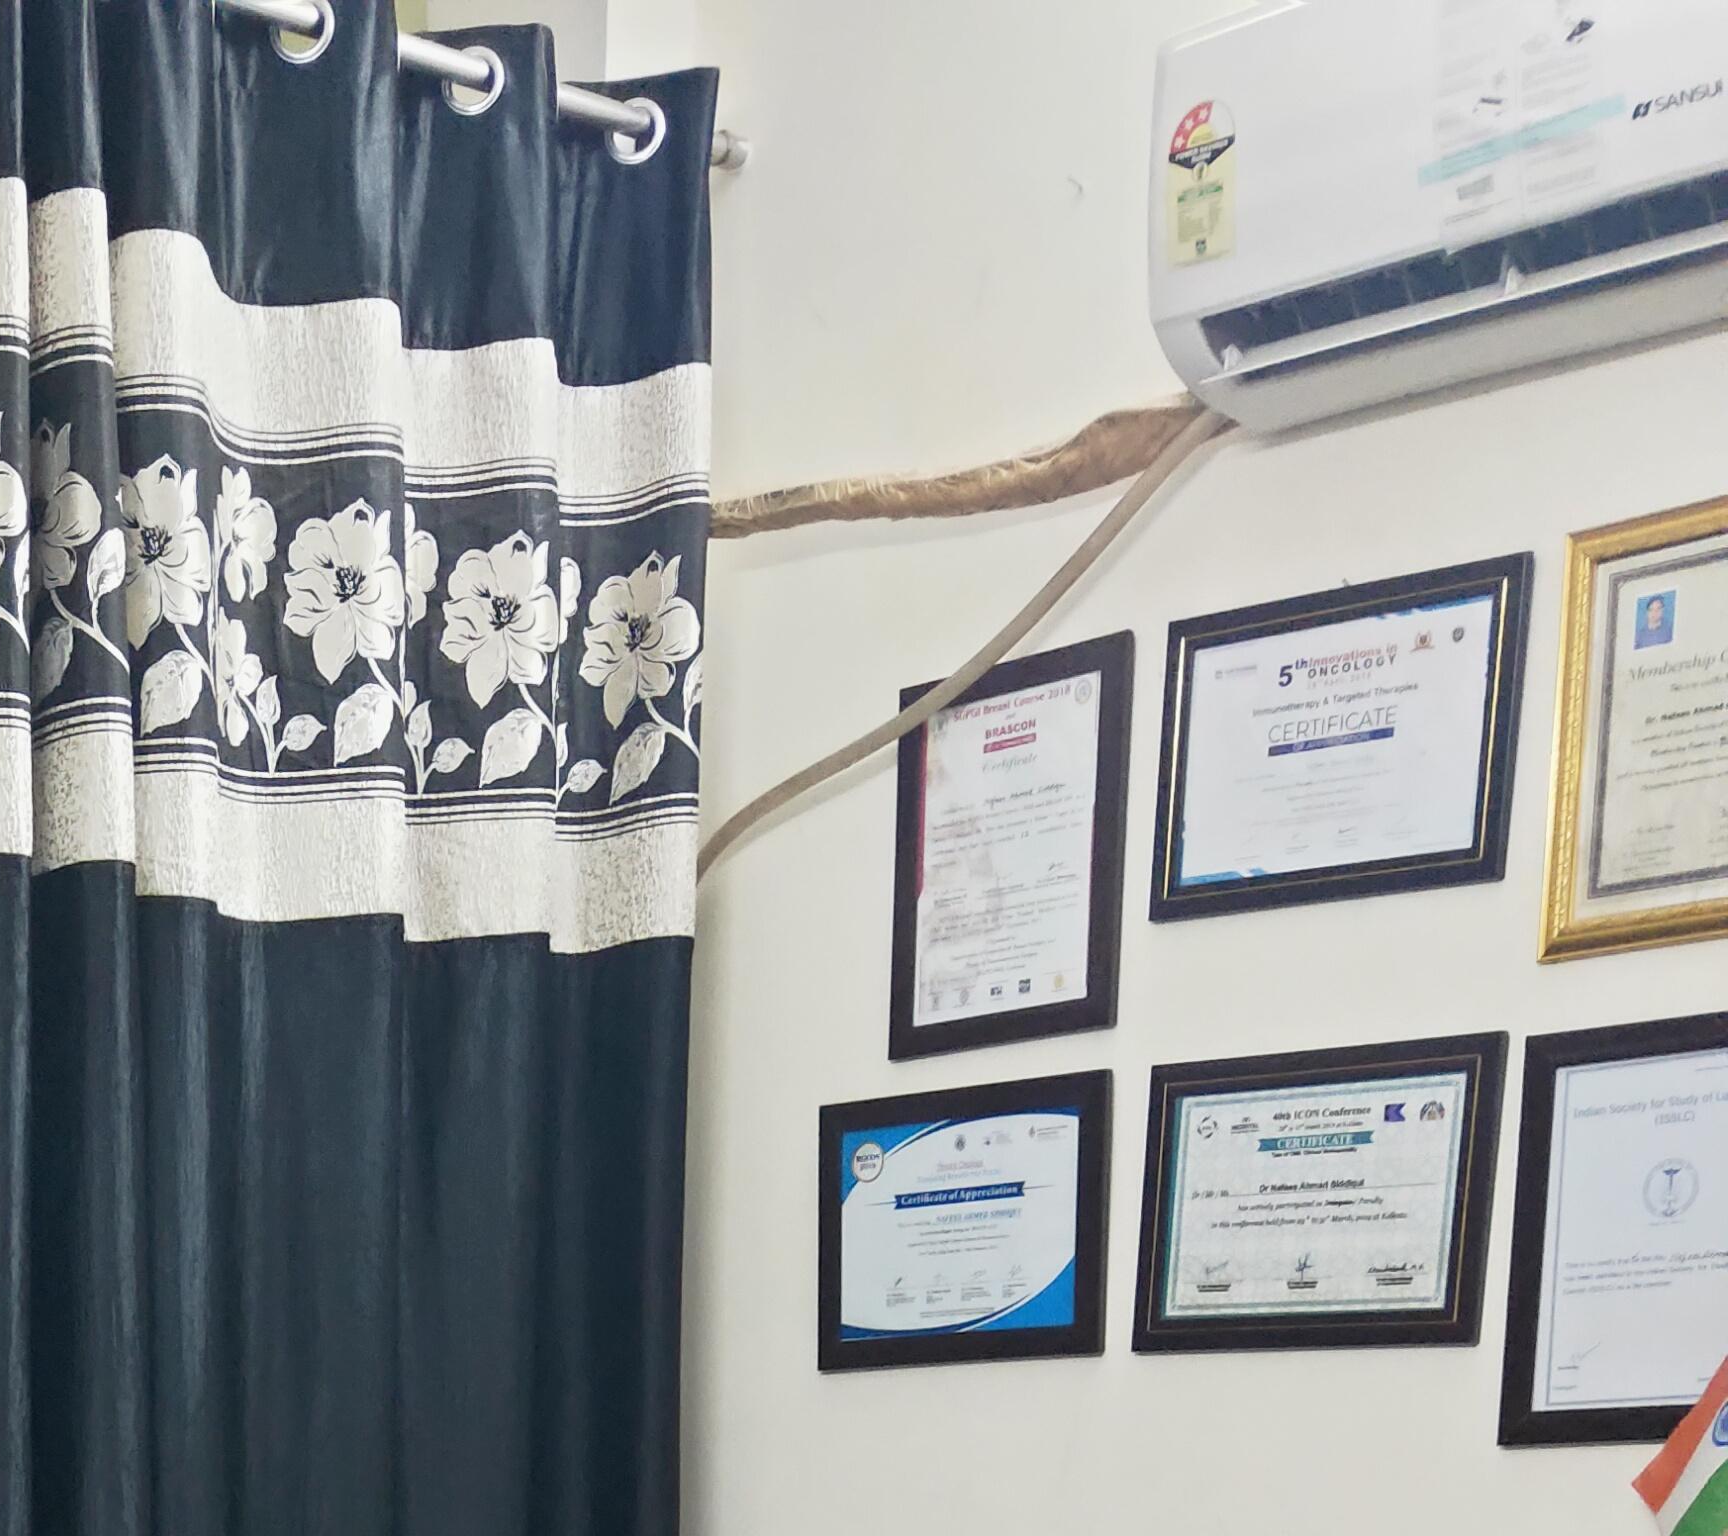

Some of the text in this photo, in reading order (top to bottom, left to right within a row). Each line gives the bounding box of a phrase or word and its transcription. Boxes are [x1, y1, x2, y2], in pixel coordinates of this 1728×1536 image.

[1308, 654, 1396, 679] ONCOLOGY
[1014, 691, 1045, 707] Course
[1333, 690, 1370, 705] Targeted
[1374, 682, 1419, 697] Therapies
[985, 719, 1037, 739] BRASCON
[1268, 705, 1398, 744] CERTIFICATE
[1322, 1106, 1372, 1119] Conference
[1277, 1133, 1354, 1149] CERTIFICATE
[901, 1192, 946, 1206] Certificate
[959, 1185, 1018, 1202] Appreciation
